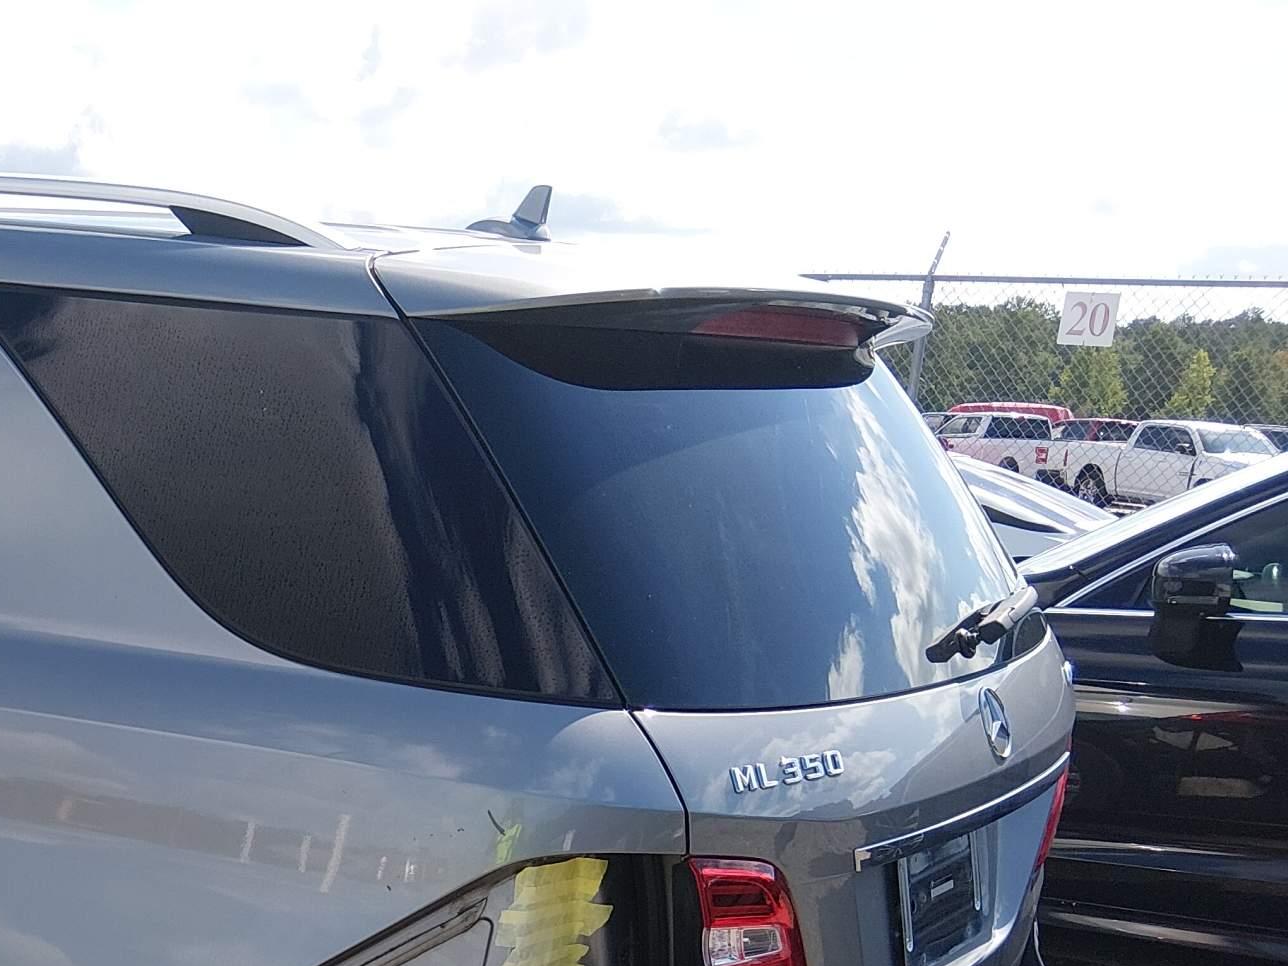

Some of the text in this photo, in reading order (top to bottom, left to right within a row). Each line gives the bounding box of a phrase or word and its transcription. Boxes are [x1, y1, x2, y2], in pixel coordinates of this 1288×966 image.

[1065, 301, 1110, 337] 20
[729, 750, 845, 793] ML 350
